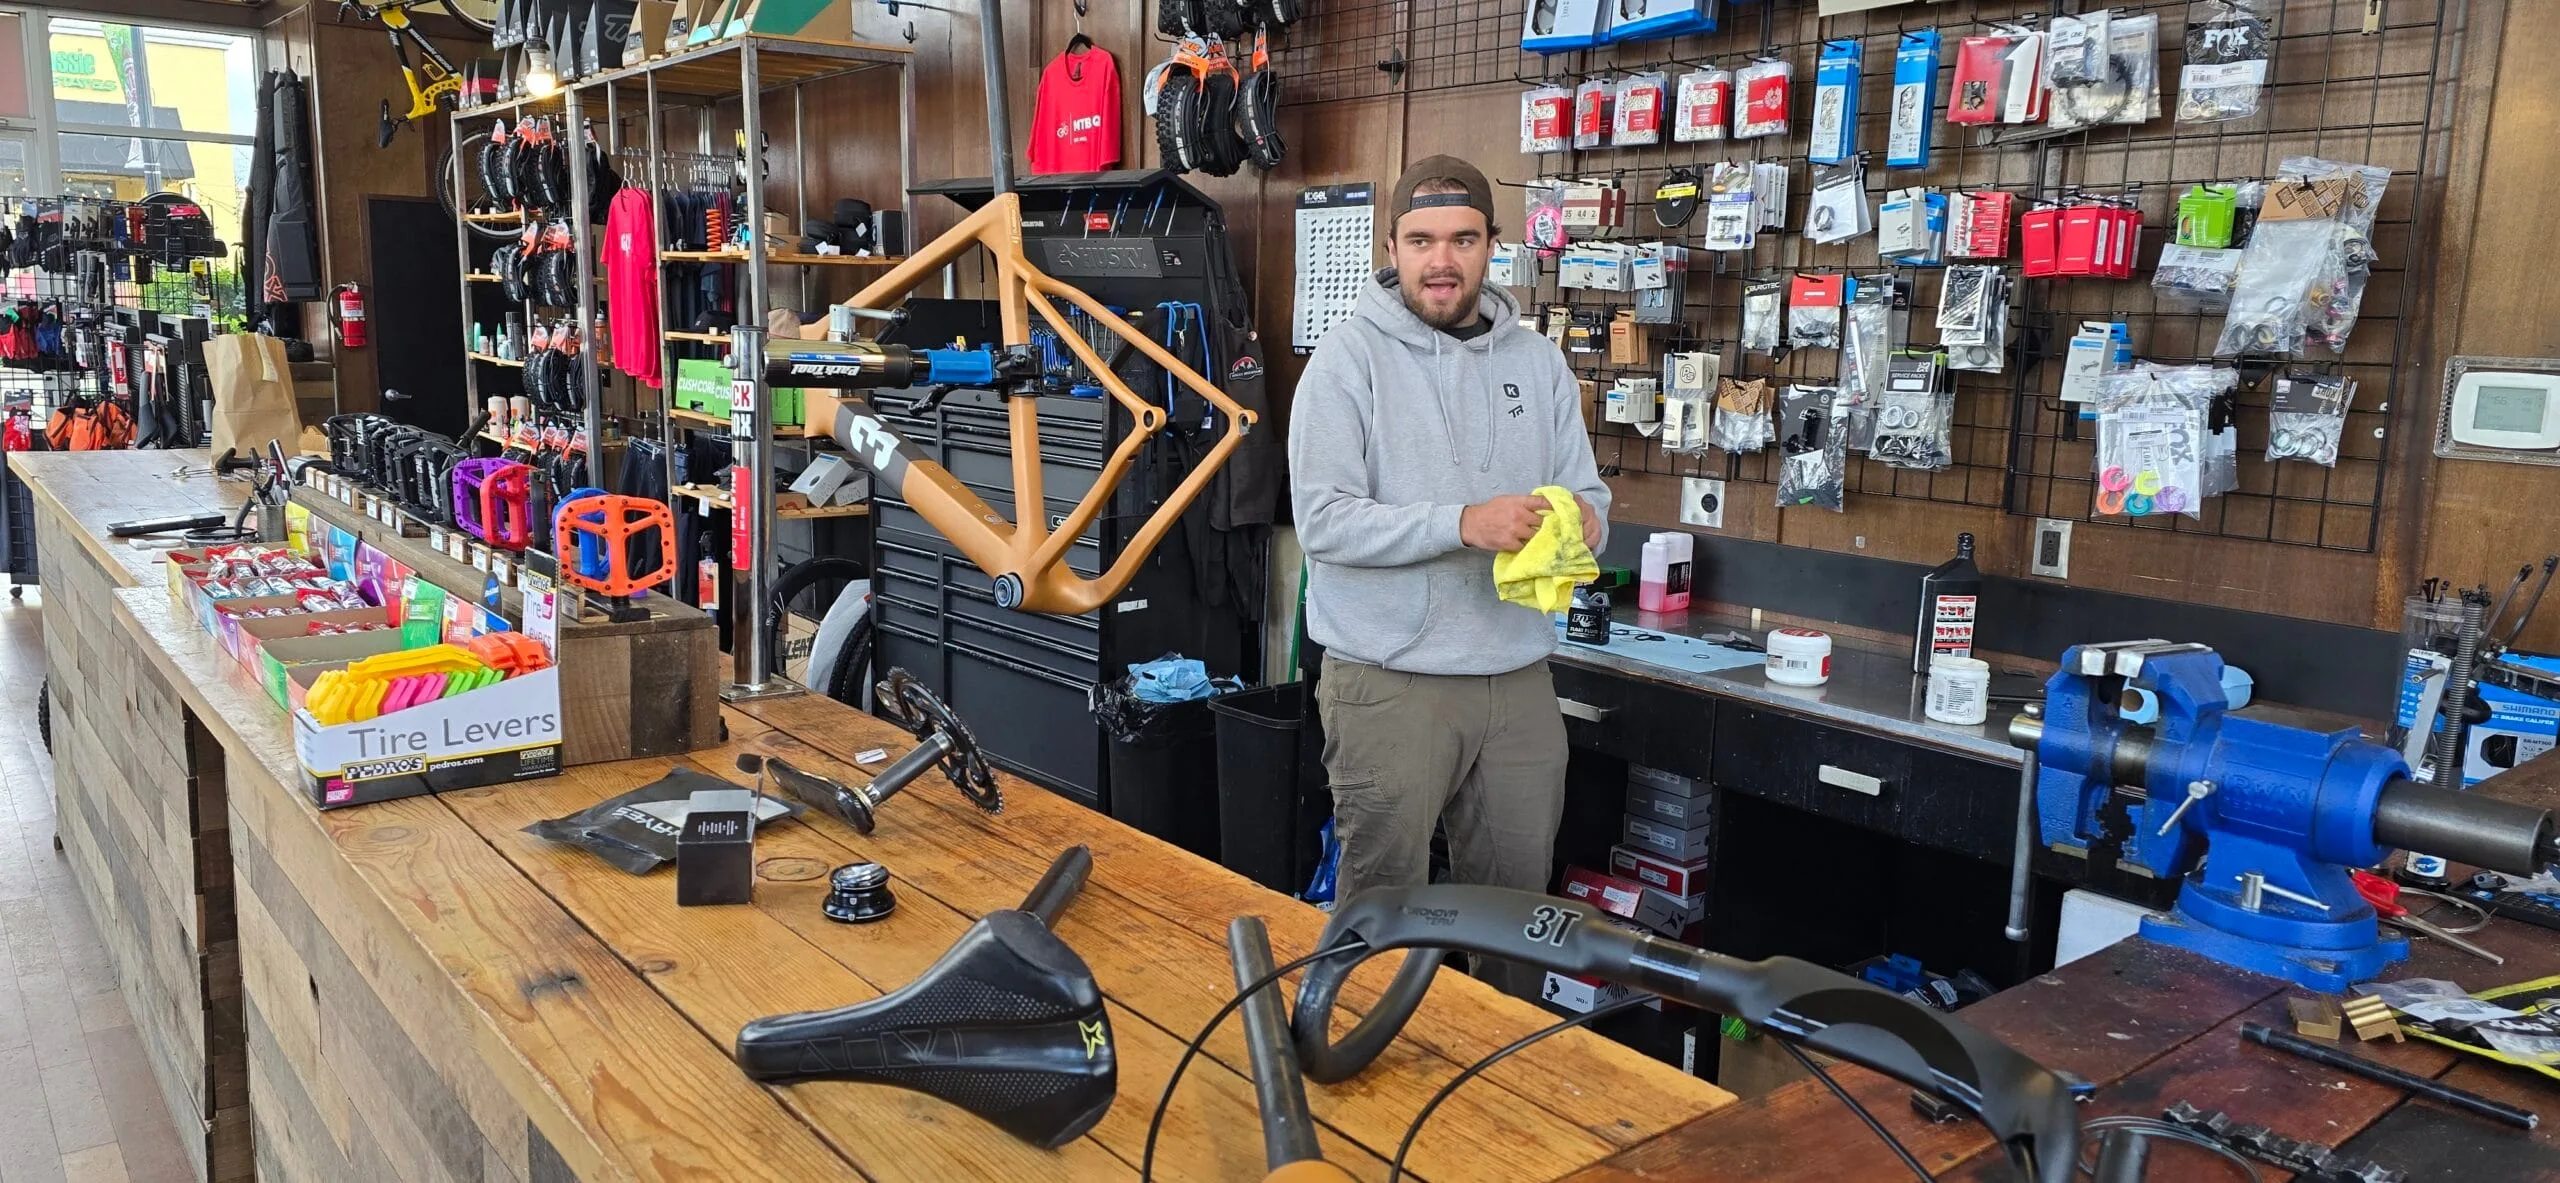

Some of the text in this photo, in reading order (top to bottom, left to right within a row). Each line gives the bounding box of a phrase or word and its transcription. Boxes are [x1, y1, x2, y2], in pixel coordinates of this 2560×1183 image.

[2202, 26, 2249, 56] FOX
[1073, 117, 1092, 131] MTB
[790, 363, 861, 377] Park Tool
[1572, 613, 1597, 627] FOX
[2502, 703, 2557, 716] SHIMANO
[2525, 717, 2556, 726] CALIPER
[348, 713, 556, 758] Tire Levers
[430, 757, 484, 773] pedros.com
[520, 756, 555, 767] LIFETIME
[1523, 904, 1584, 948] 3T
